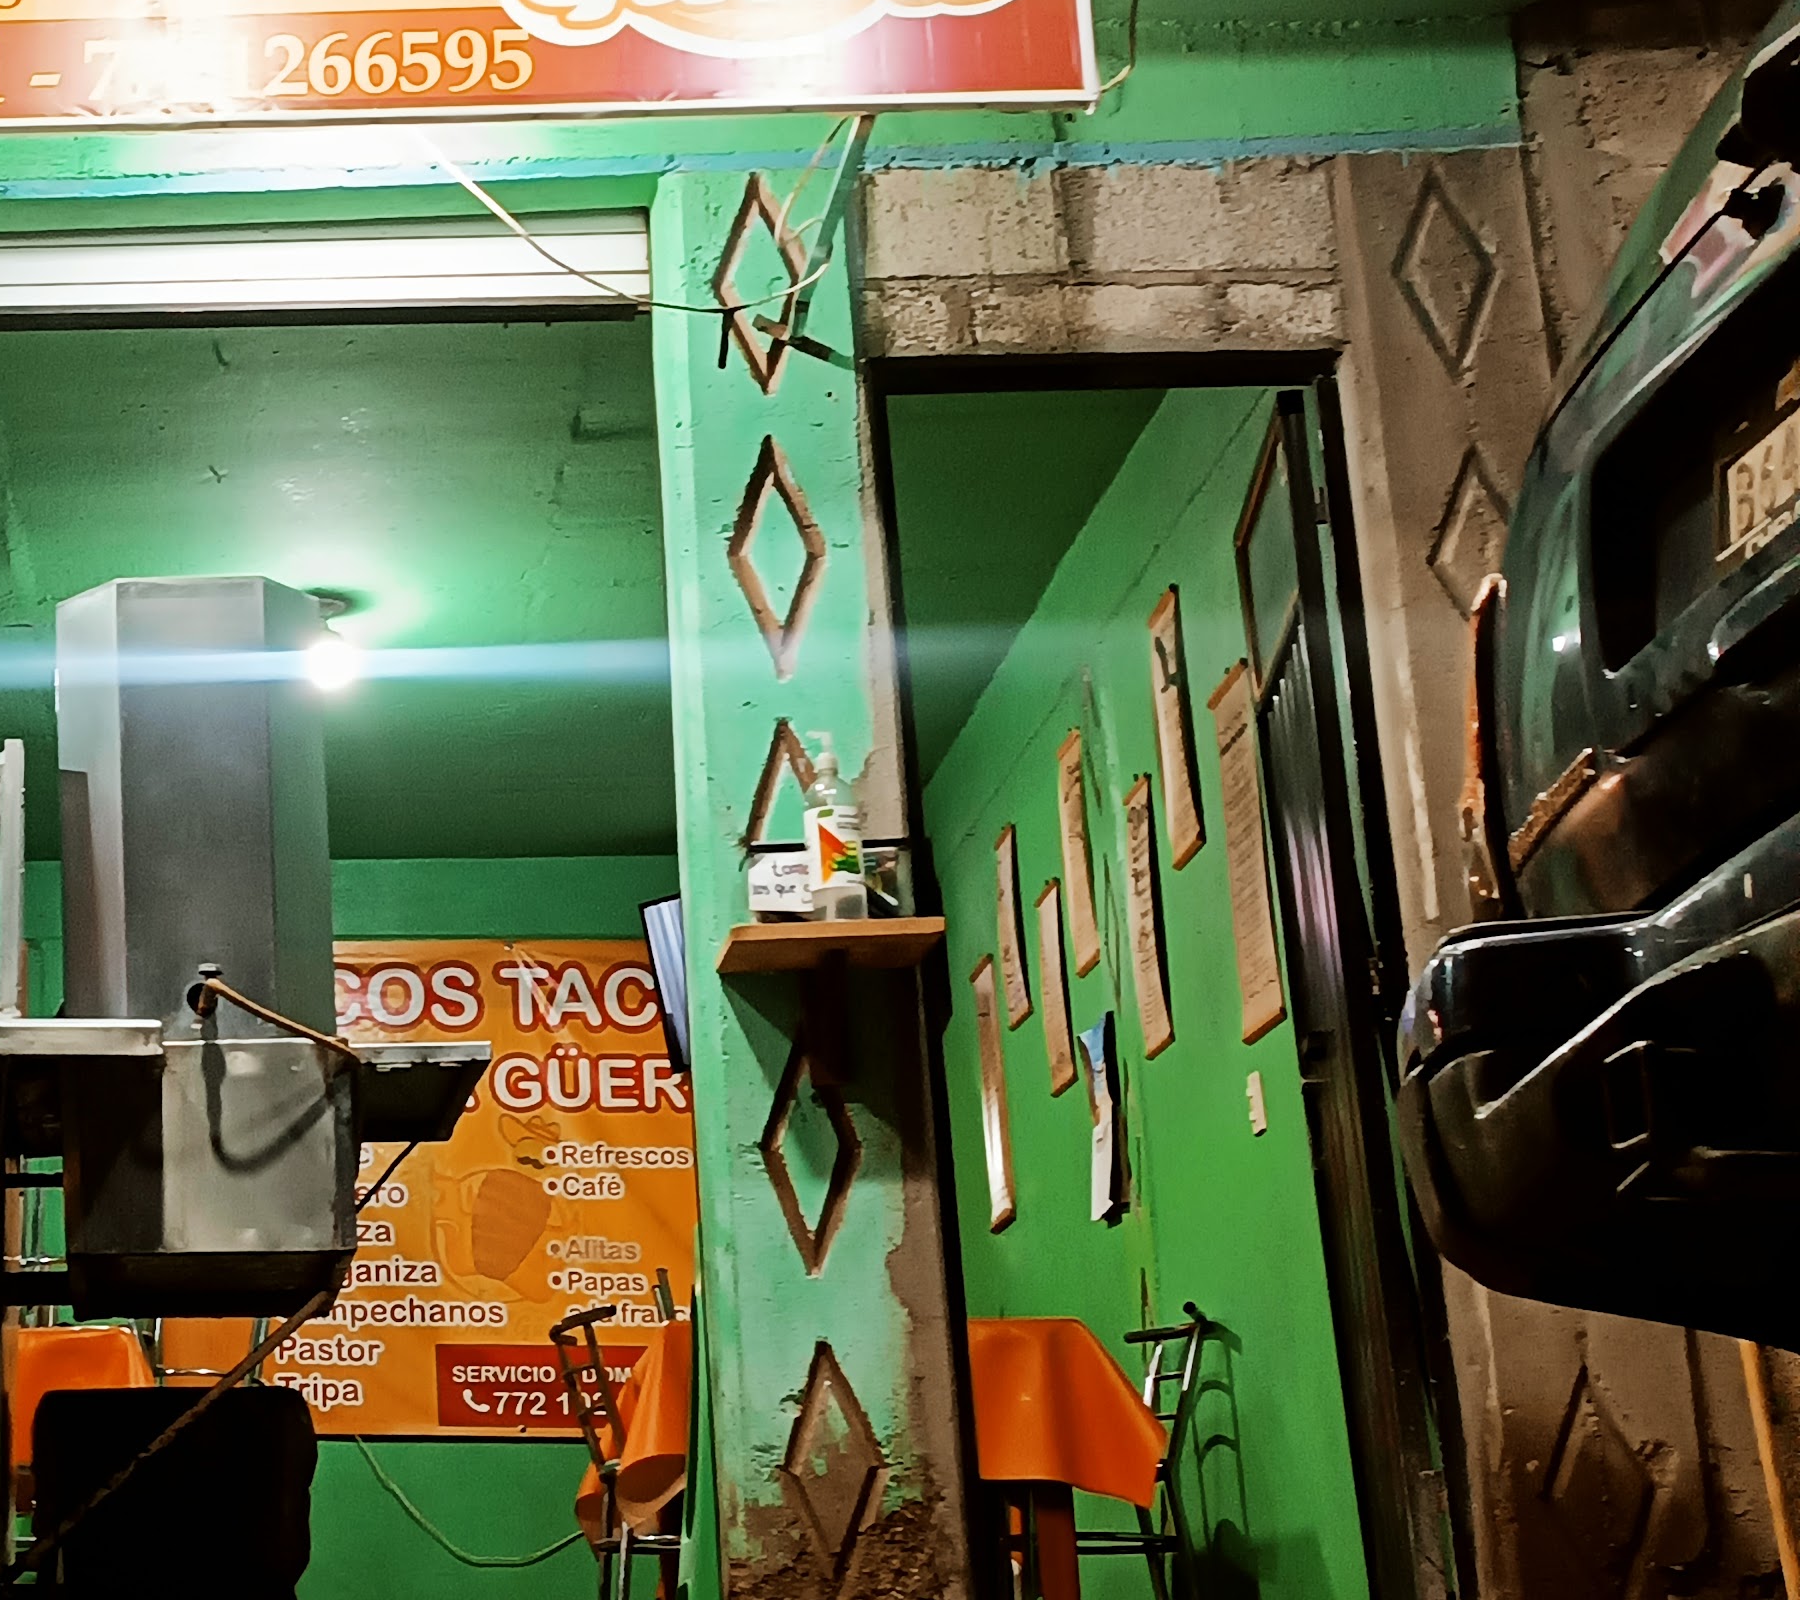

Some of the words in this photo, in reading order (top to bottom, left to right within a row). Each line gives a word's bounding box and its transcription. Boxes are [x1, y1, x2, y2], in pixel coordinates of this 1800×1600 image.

[83, 28, 534, 102] 71266595
[334, 966, 479, 1028] COS
[499, 966, 659, 1028] TAC
[493, 1046, 688, 1109] GÜER
[561, 1144, 690, 1166] Refrescos
[562, 1174, 622, 1197] Café
[564, 1238, 638, 1261] Alitas
[566, 1270, 645, 1296] Papas
[330, 1297, 505, 1329] mpechanos
[279, 1336, 381, 1363] Pastor
[451, 1365, 556, 1383] SERVICIO
[492, 1392, 547, 1416] 772
